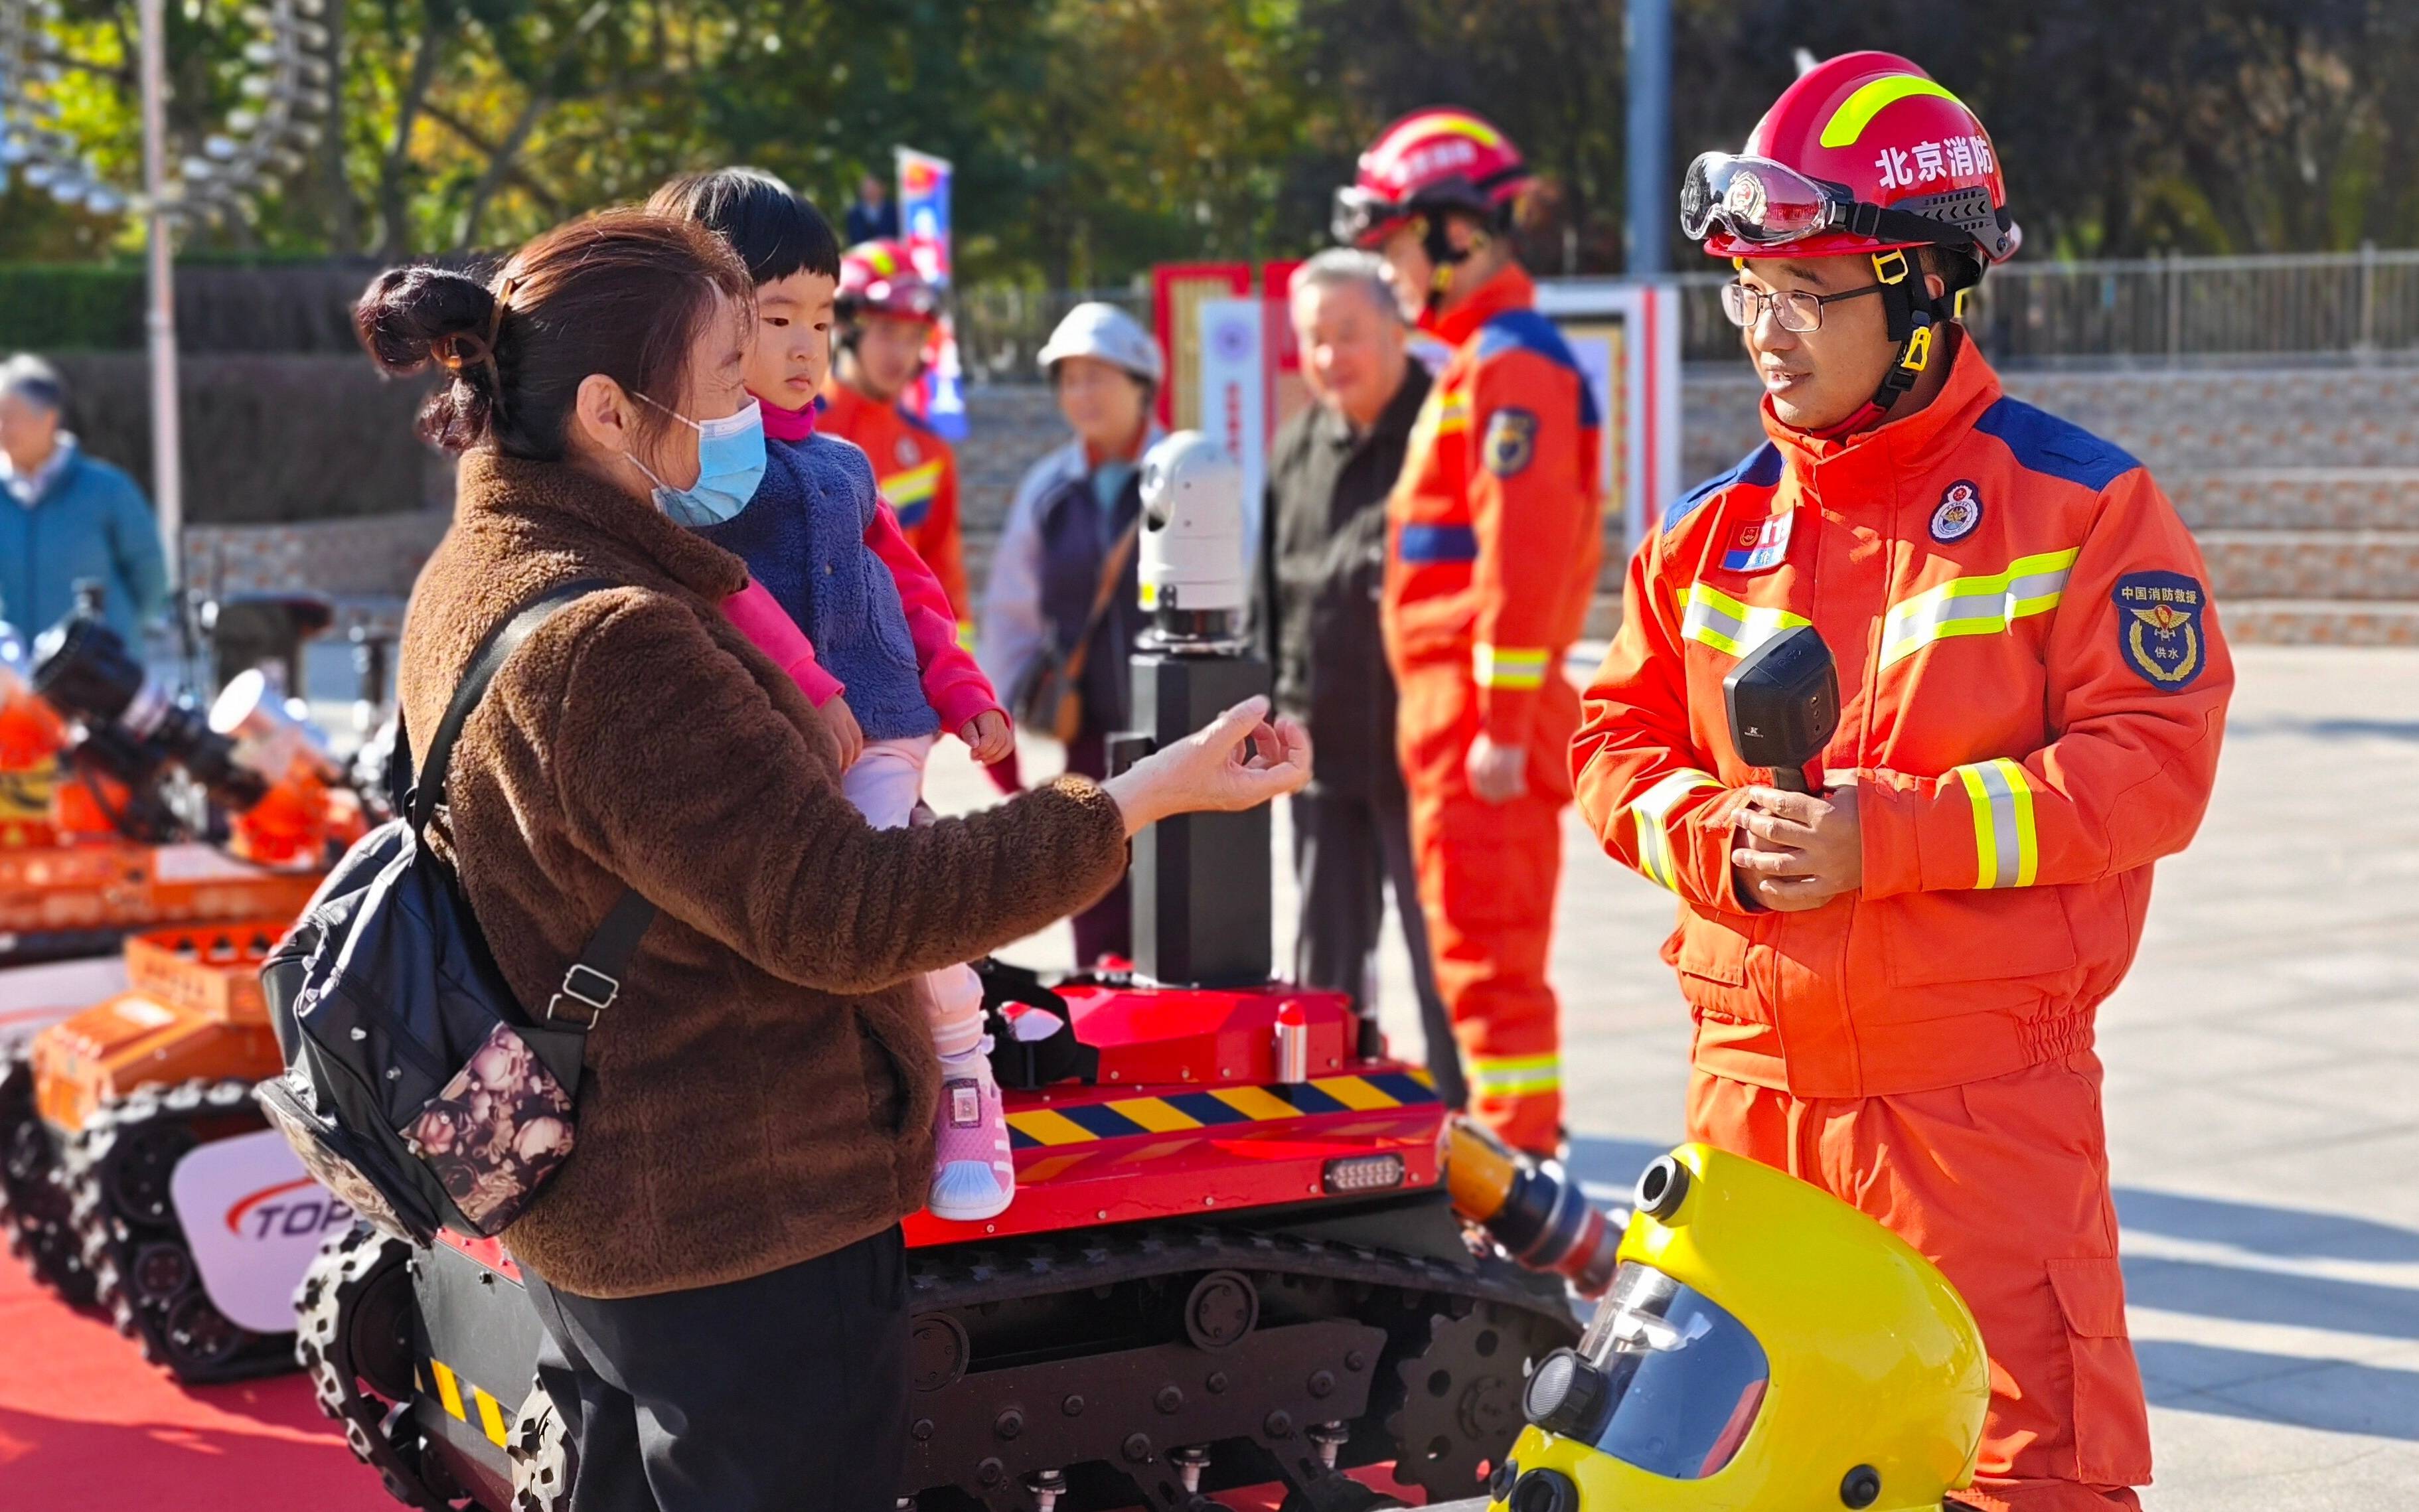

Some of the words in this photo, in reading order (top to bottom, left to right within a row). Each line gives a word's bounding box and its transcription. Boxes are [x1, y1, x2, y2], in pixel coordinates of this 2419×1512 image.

[1875, 135, 1993, 189] 北京消防
[2121, 585, 2197, 605] 中国消防救援
[2154, 645, 2179, 660] 供水
